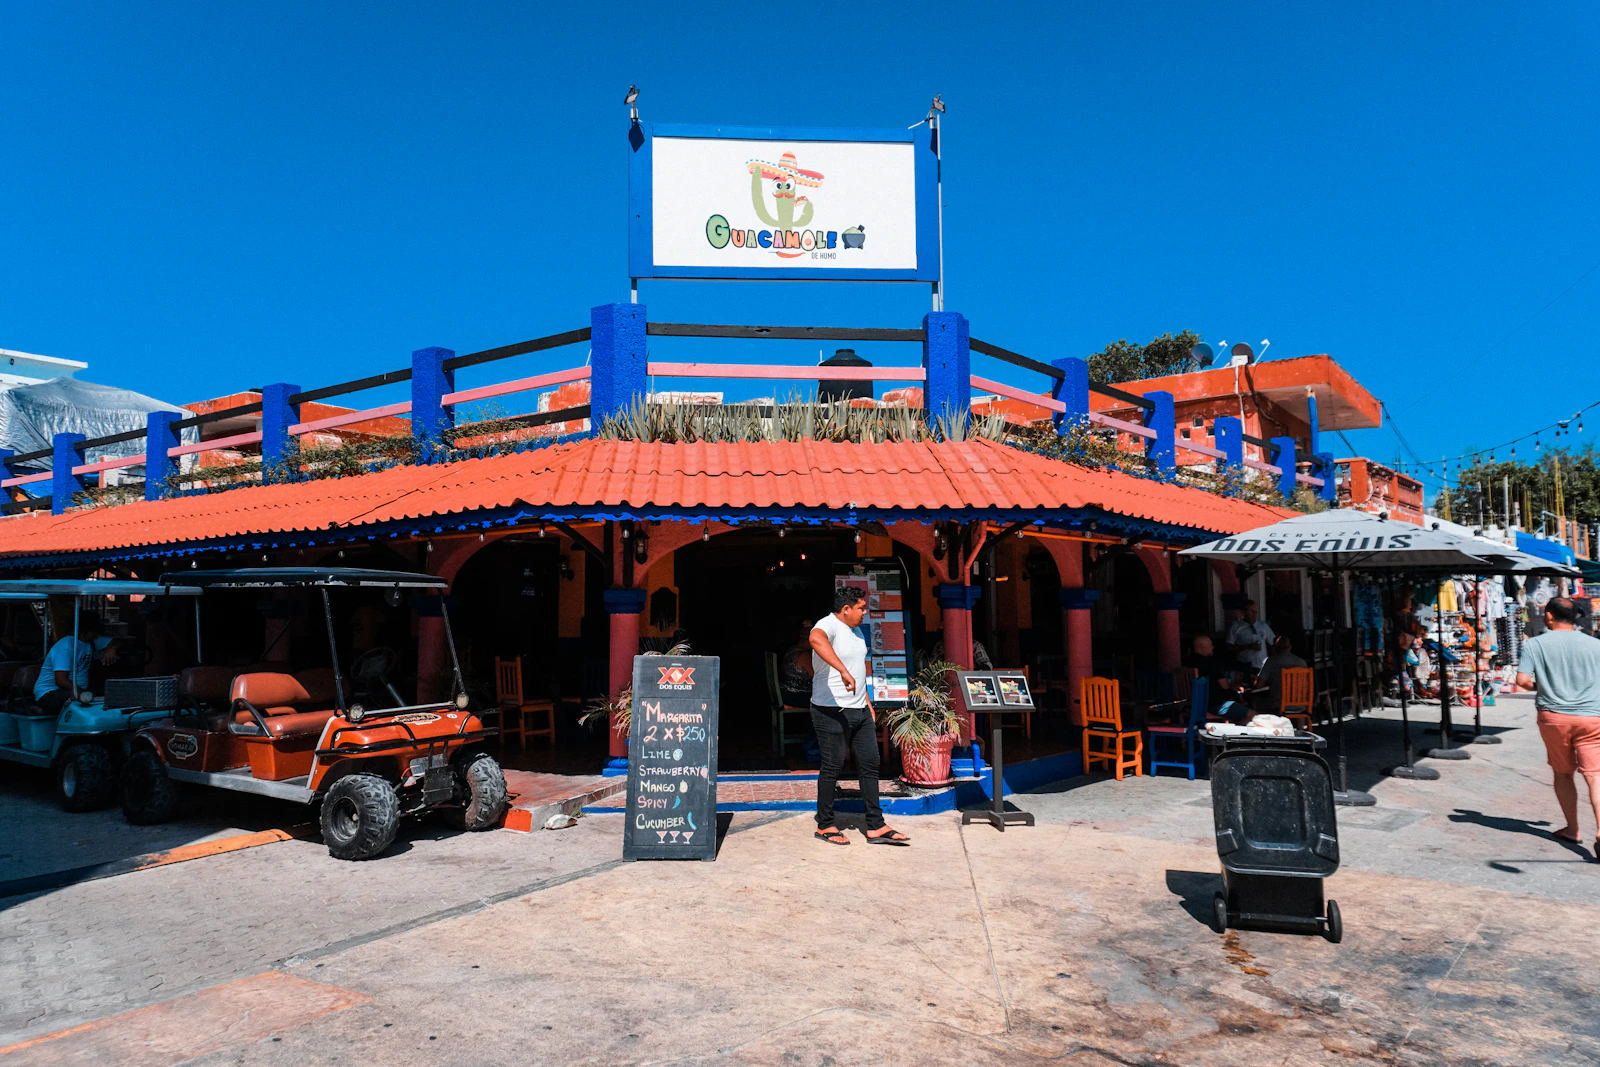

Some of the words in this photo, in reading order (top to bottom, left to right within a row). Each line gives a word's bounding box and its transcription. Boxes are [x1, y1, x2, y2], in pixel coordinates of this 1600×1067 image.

[706, 214, 837, 252] GUACAMOLE
[811, 252, 819, 260] DE
[820, 252, 837, 260] HUMO
[1269, 530, 1361, 538] CERVEZA
[1211, 538, 1286, 552] DOS
[1294, 534, 1413, 552] EQUIS
[643, 725, 658, 743] 2
[676, 724, 706, 743] $250
[641, 745, 671, 760] LIME
[639, 765, 701, 777] STRAWBERRY
[640, 780, 676, 793] MANGO
[637, 795, 668, 809] SPICY
[635, 813, 686, 831] CUCUMBER
